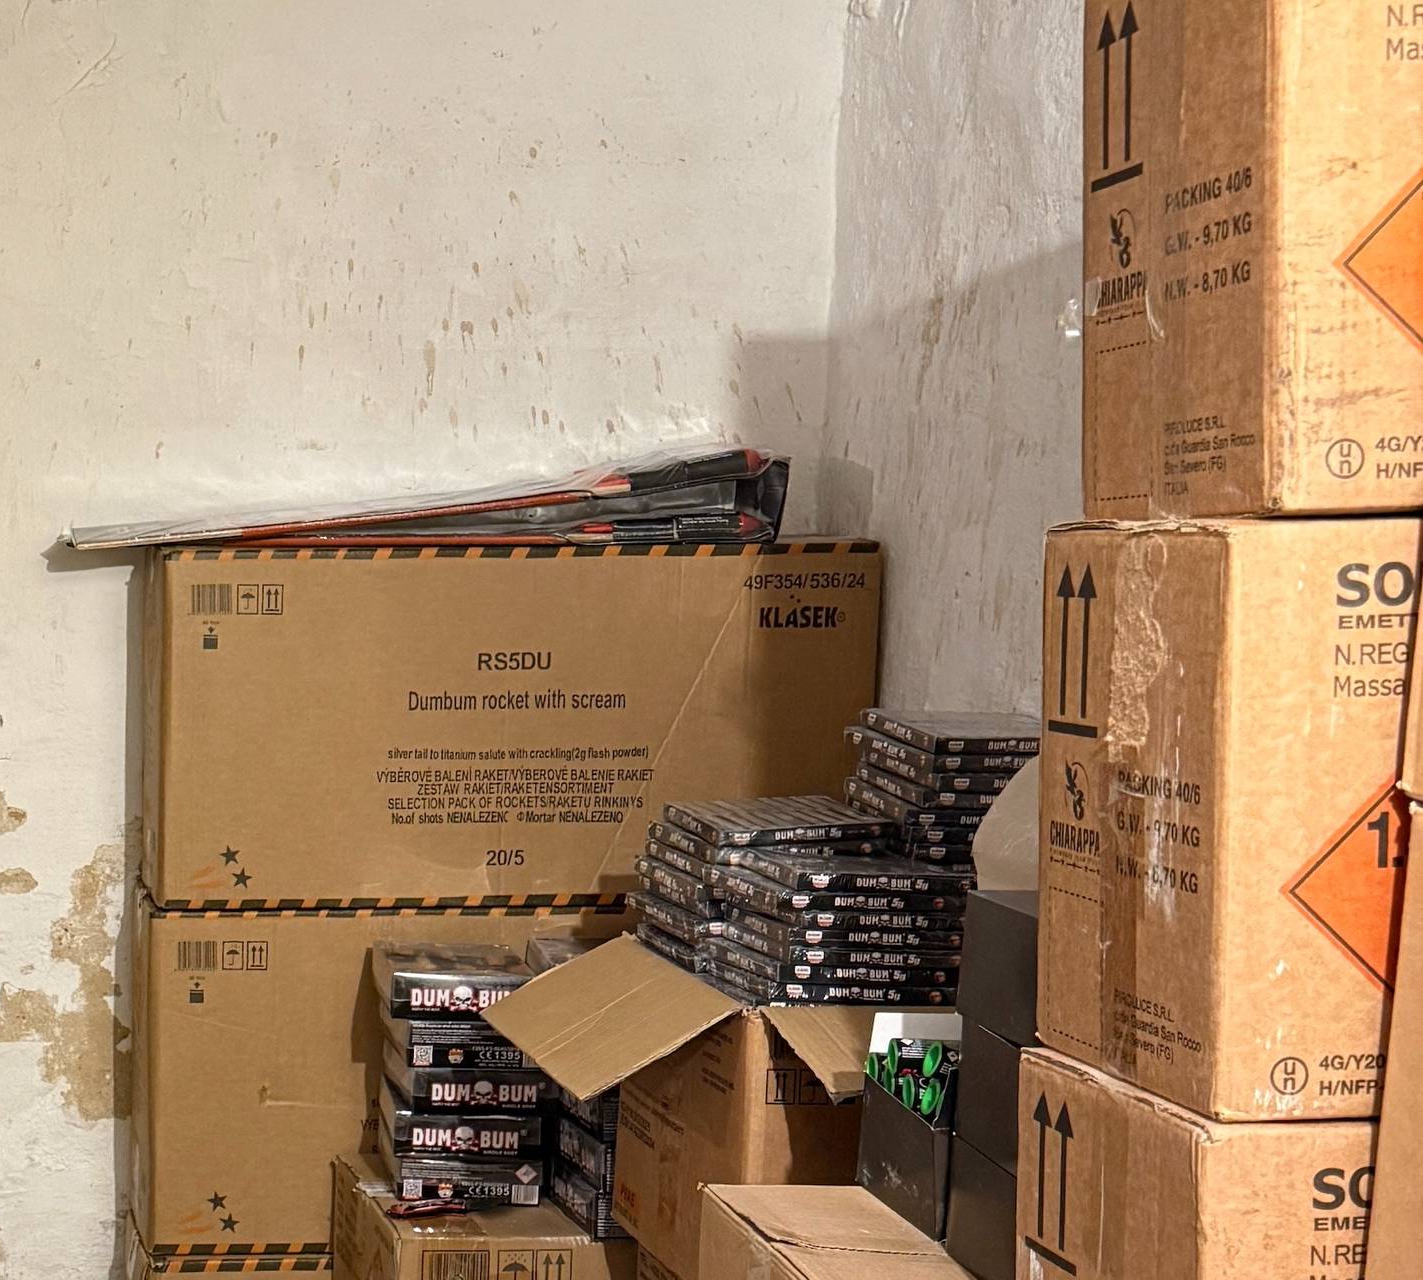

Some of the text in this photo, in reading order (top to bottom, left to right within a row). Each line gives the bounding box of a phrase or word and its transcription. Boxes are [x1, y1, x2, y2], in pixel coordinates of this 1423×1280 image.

[1165, 166, 1252, 214] PACKING 40/6
[1203, 219, 1229, 248] 9,70
[1233, 211, 1252, 236] KG
[1202, 267, 1228, 295] 8,70
[1232, 261, 1251, 285] KG
[1212, 435, 1228, 451] San
[1375, 435, 1423, 453] 4G/Y
[478, 652, 552, 671] RS5DU
[408, 689, 626, 711] Dumbum rocket with scream
[388, 748, 413, 760] silver
[414, 748, 428, 760] tail
[430, 749, 439, 760] to
[440, 749, 476, 760] titanium
[478, 749, 506, 760] salute
[508, 747, 528, 759] with
[588, 747, 610, 759] flash
[612, 745, 649, 761] powder)
[988, 741, 1007, 750] DUM
[570, 769, 615, 781] BALENIE
[617, 769, 655, 781] RAKIET
[417, 783, 460, 796] ZESTAW
[1175, 782, 1201, 805] 40/6
[388, 798, 445, 810] SELECTION
[448, 797, 476, 809] PACK
[479, 796, 493, 809] OF
[594, 796, 644, 809] RINKINYS
[419, 812, 444, 825] shots
[775, 831, 794, 841] DUM
[1050, 820, 1100, 858] CHIARAPPA
[1181, 825, 1200, 847] KG
[486, 850, 525, 866] 20/5
[856, 877, 877, 887] DUM
[891, 878, 913, 889] BUM
[1180, 871, 1199, 894] KG
[834, 897, 855, 907] DUM
[868, 897, 889, 907] BUM
[859, 915, 879, 925] DUM
[893, 916, 913, 926] BUM
[848, 933, 869, 942] DUM
[882, 933, 903, 944] BUM
[850, 953, 870, 963] DUM
[884, 954, 904, 964] BUM
[836, 968, 856, 978] DUM
[870, 969, 890, 980] BUM
[411, 988, 450, 1008] DUM
[829, 987, 850, 997] DUM
[863, 988, 884, 999] BUM
[1161, 1025, 1176, 1043] San
[432, 1083, 537, 1103] DUM BUM
[412, 1127, 519, 1149] DUM BUM
